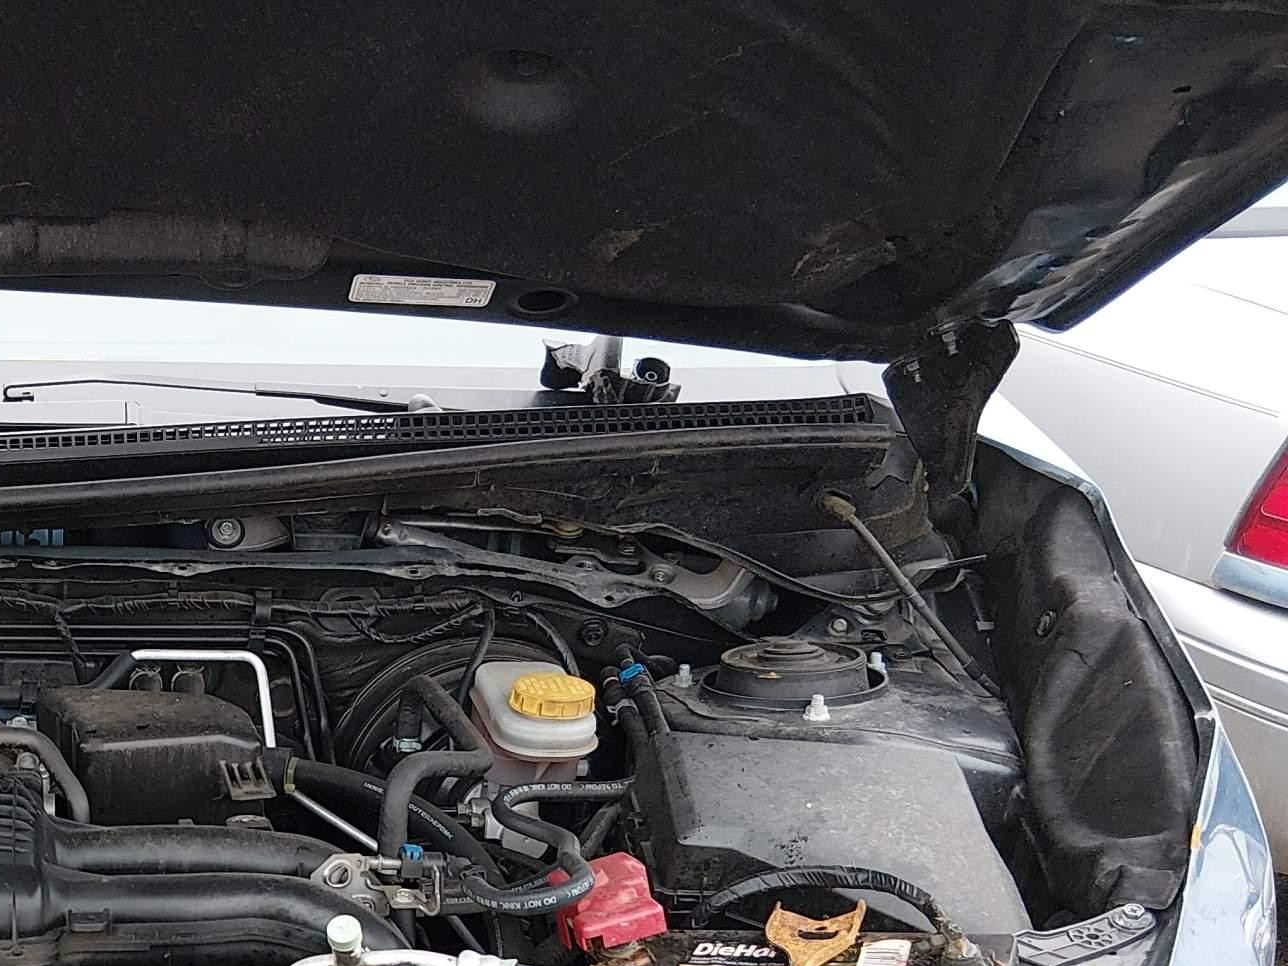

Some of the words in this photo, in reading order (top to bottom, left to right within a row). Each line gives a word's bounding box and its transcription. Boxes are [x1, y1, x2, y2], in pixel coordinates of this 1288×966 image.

[522, 898, 541, 909] NOT
[543, 895, 557, 905] DO
[692, 942, 777, 959] DieHa
